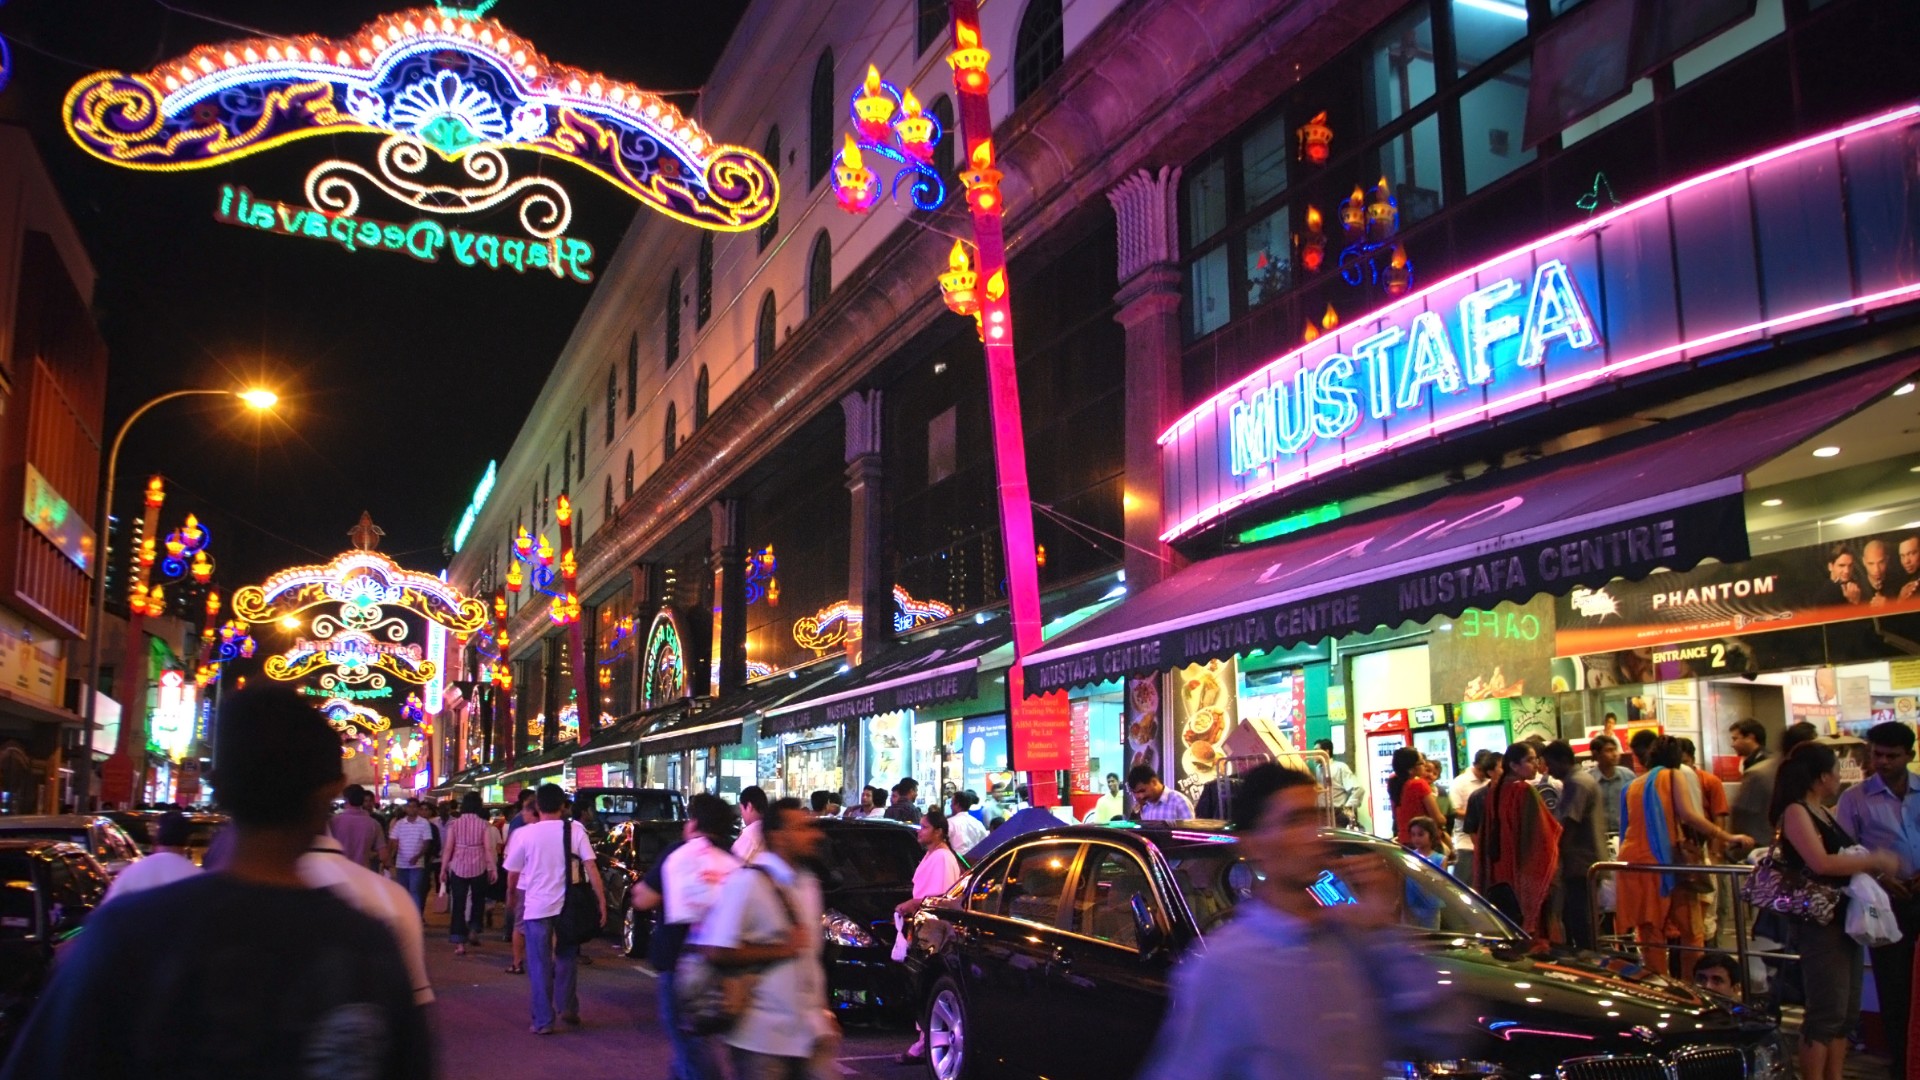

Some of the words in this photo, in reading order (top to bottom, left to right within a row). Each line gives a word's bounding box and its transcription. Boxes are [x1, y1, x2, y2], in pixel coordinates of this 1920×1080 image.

[1229, 258, 1600, 477] MUSTAFA
[1399, 555, 1527, 612] MUSTAFA
[1538, 519, 1677, 582] CENTRE
[1652, 576, 1775, 610] PHANTOM
[1184, 616, 1267, 657] MUSTAFA
[1274, 594, 1360, 638] CENTRE
[1039, 654, 1097, 688] MUSTAFA
[1102, 640, 1160, 674] CENTRE
[1652, 646, 1707, 664] ENTRANCE
[1710, 643, 1726, 668] 2
[895, 684, 933, 706] MUSTAFA
[935, 677, 958, 697] CAFE
[826, 701, 857, 721] MUSTAFA
[856, 697, 875, 714] CAFE
[1178, 773, 1198, 791] Taste
